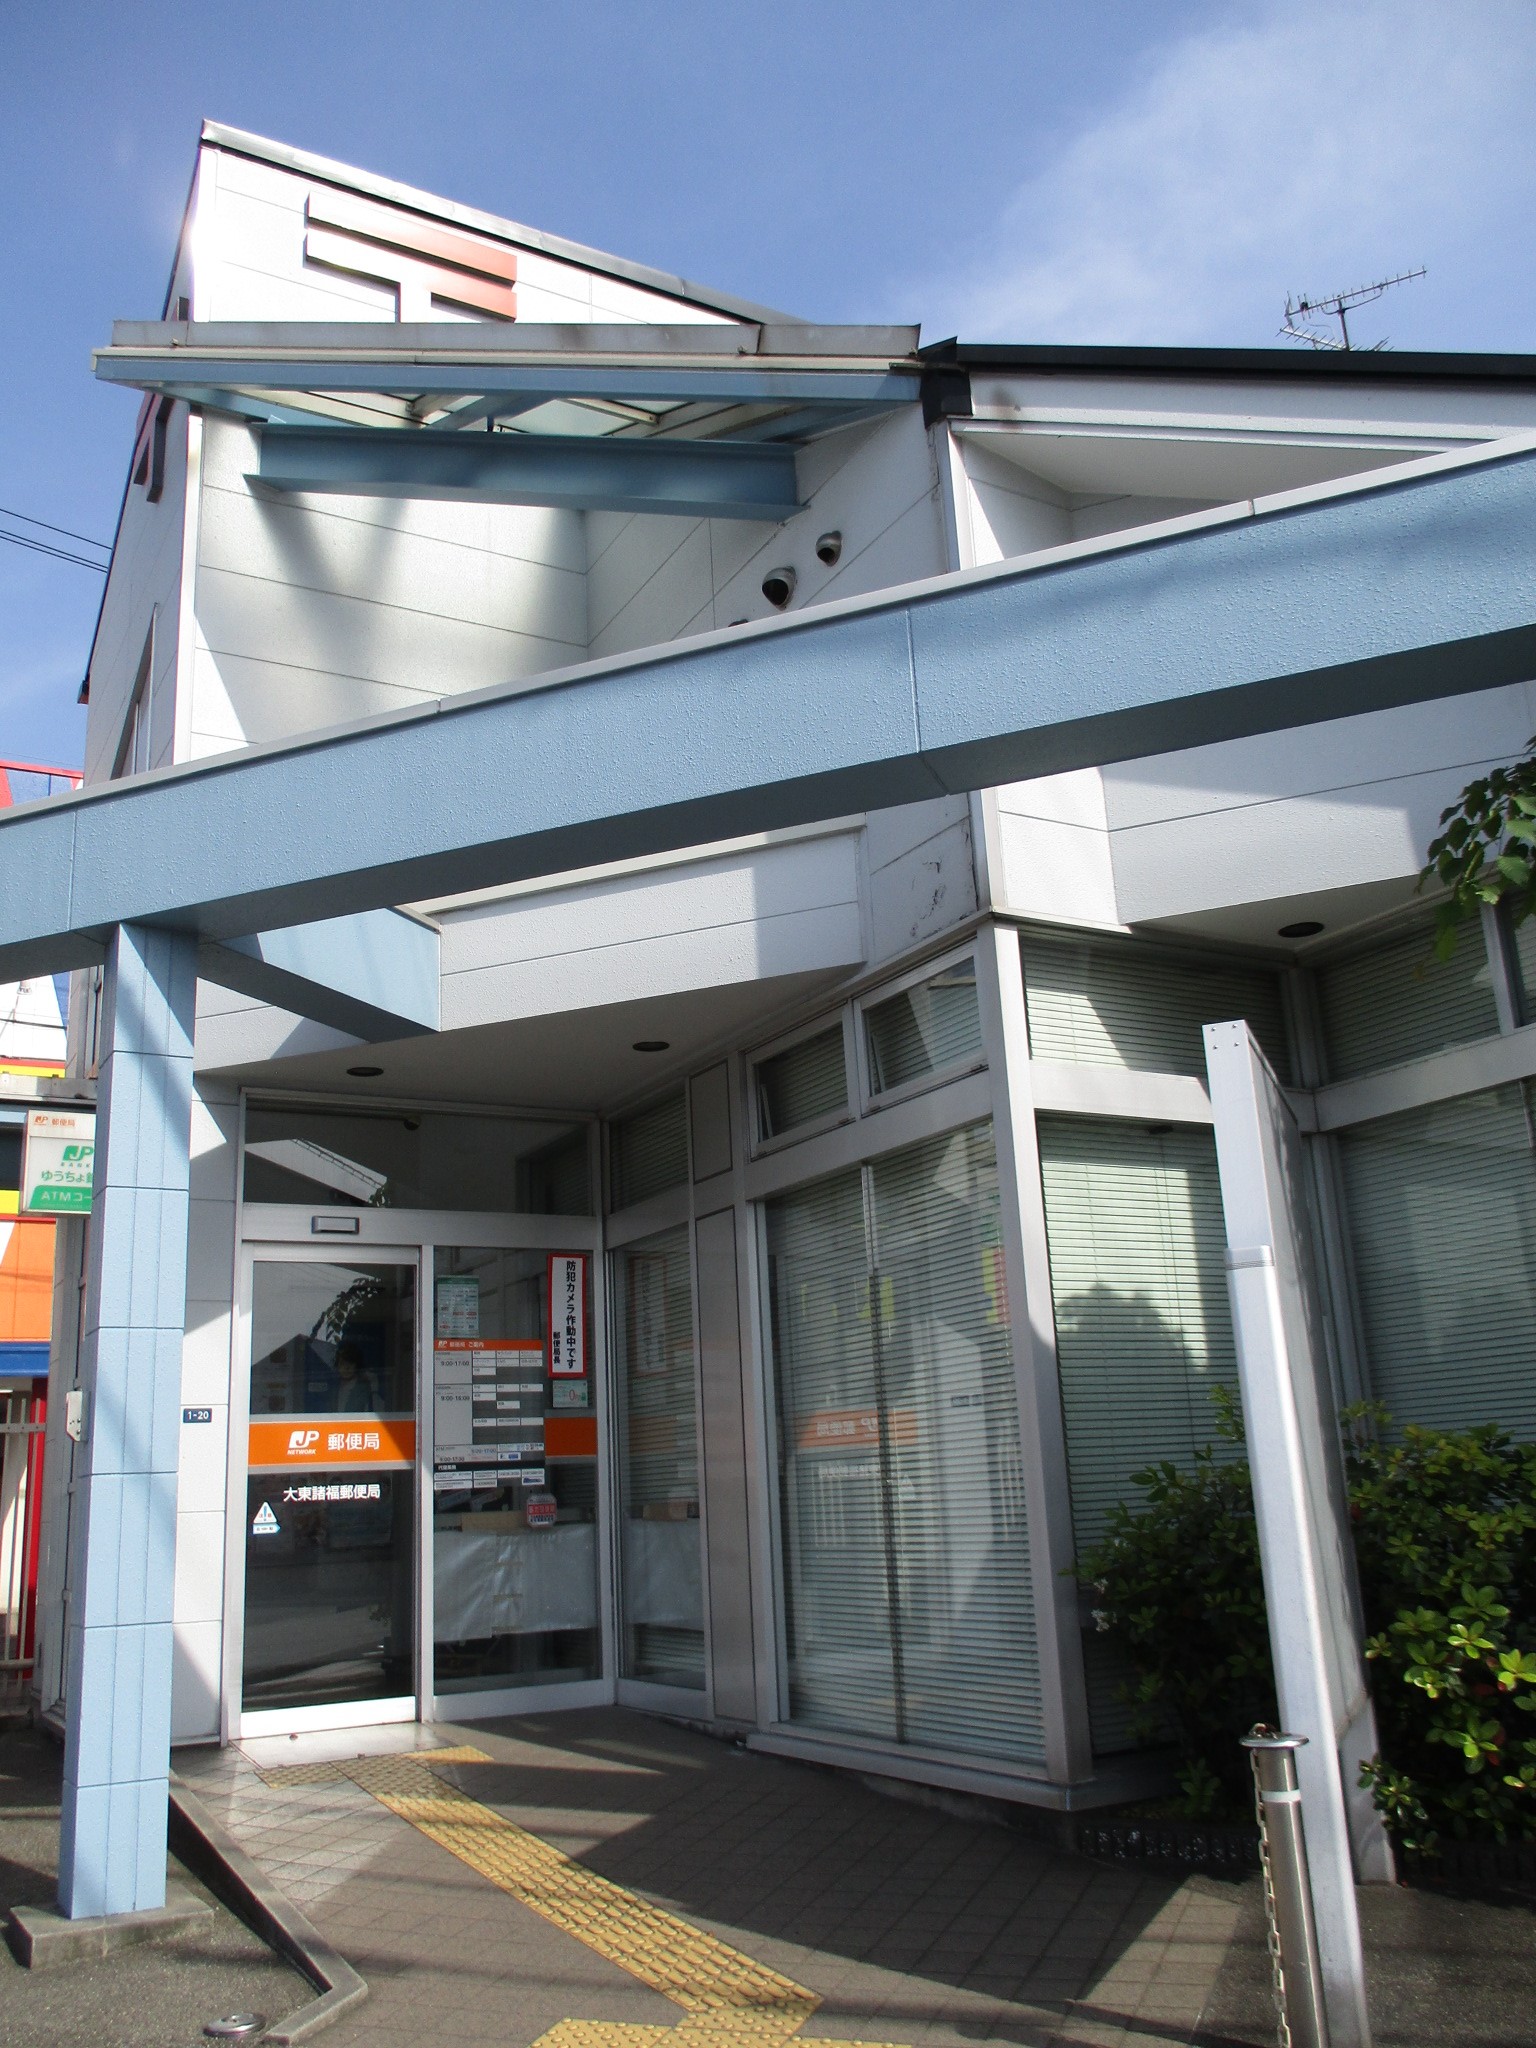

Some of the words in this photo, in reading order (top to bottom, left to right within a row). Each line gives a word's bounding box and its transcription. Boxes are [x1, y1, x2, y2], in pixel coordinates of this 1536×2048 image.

[51, 1118, 75, 1127] 郵便局
[62, 1145, 93, 1161] JP
[566, 1260, 577, 1369] 防犯カメラ作動中です
[553, 1331, 561, 1364] 郵便局長
[187, 1410, 209, 1420] 1-20
[288, 1430, 320, 1449] JP
[327, 1433, 380, 1451] 郵便局
[283, 1484, 381, 1502] 大東諸福郵便局
